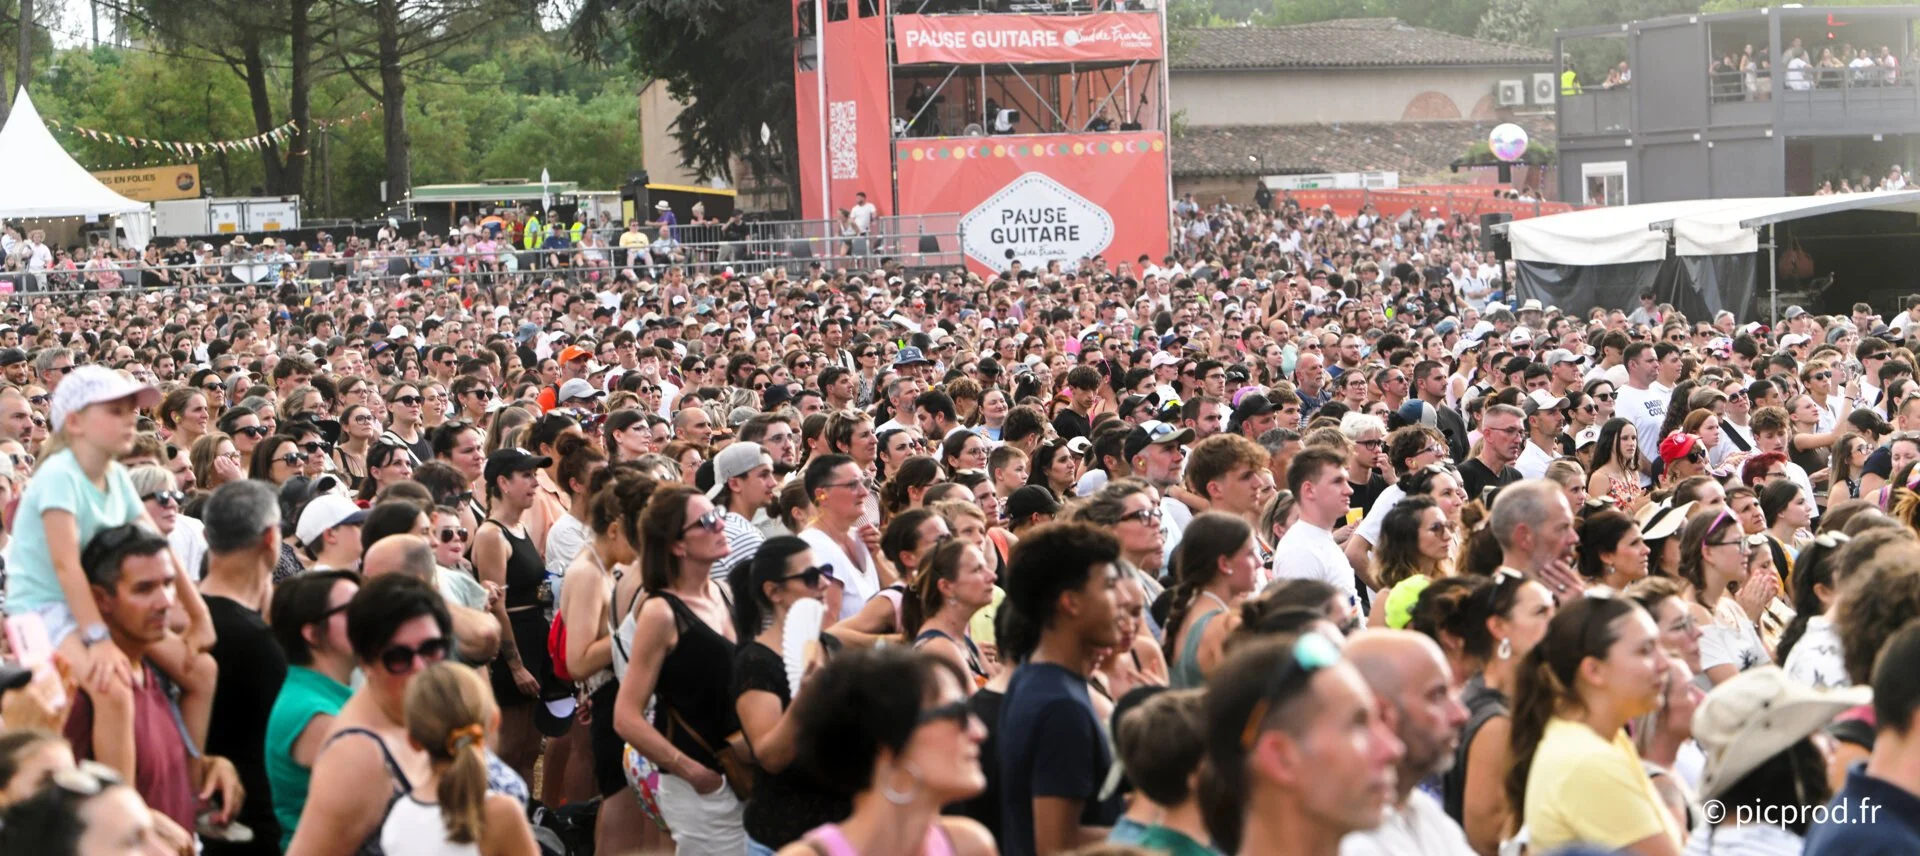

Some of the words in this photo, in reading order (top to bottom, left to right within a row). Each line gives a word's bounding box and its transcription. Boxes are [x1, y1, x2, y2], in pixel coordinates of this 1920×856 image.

[905, 30, 967, 48] PAUSE
[971, 29, 1059, 48] GUITARE
[114, 176, 126, 184] EN
[127, 174, 156, 183] FOLIES
[1002, 207, 1067, 225] PAUSE
[991, 225, 1080, 244] GUITARE
